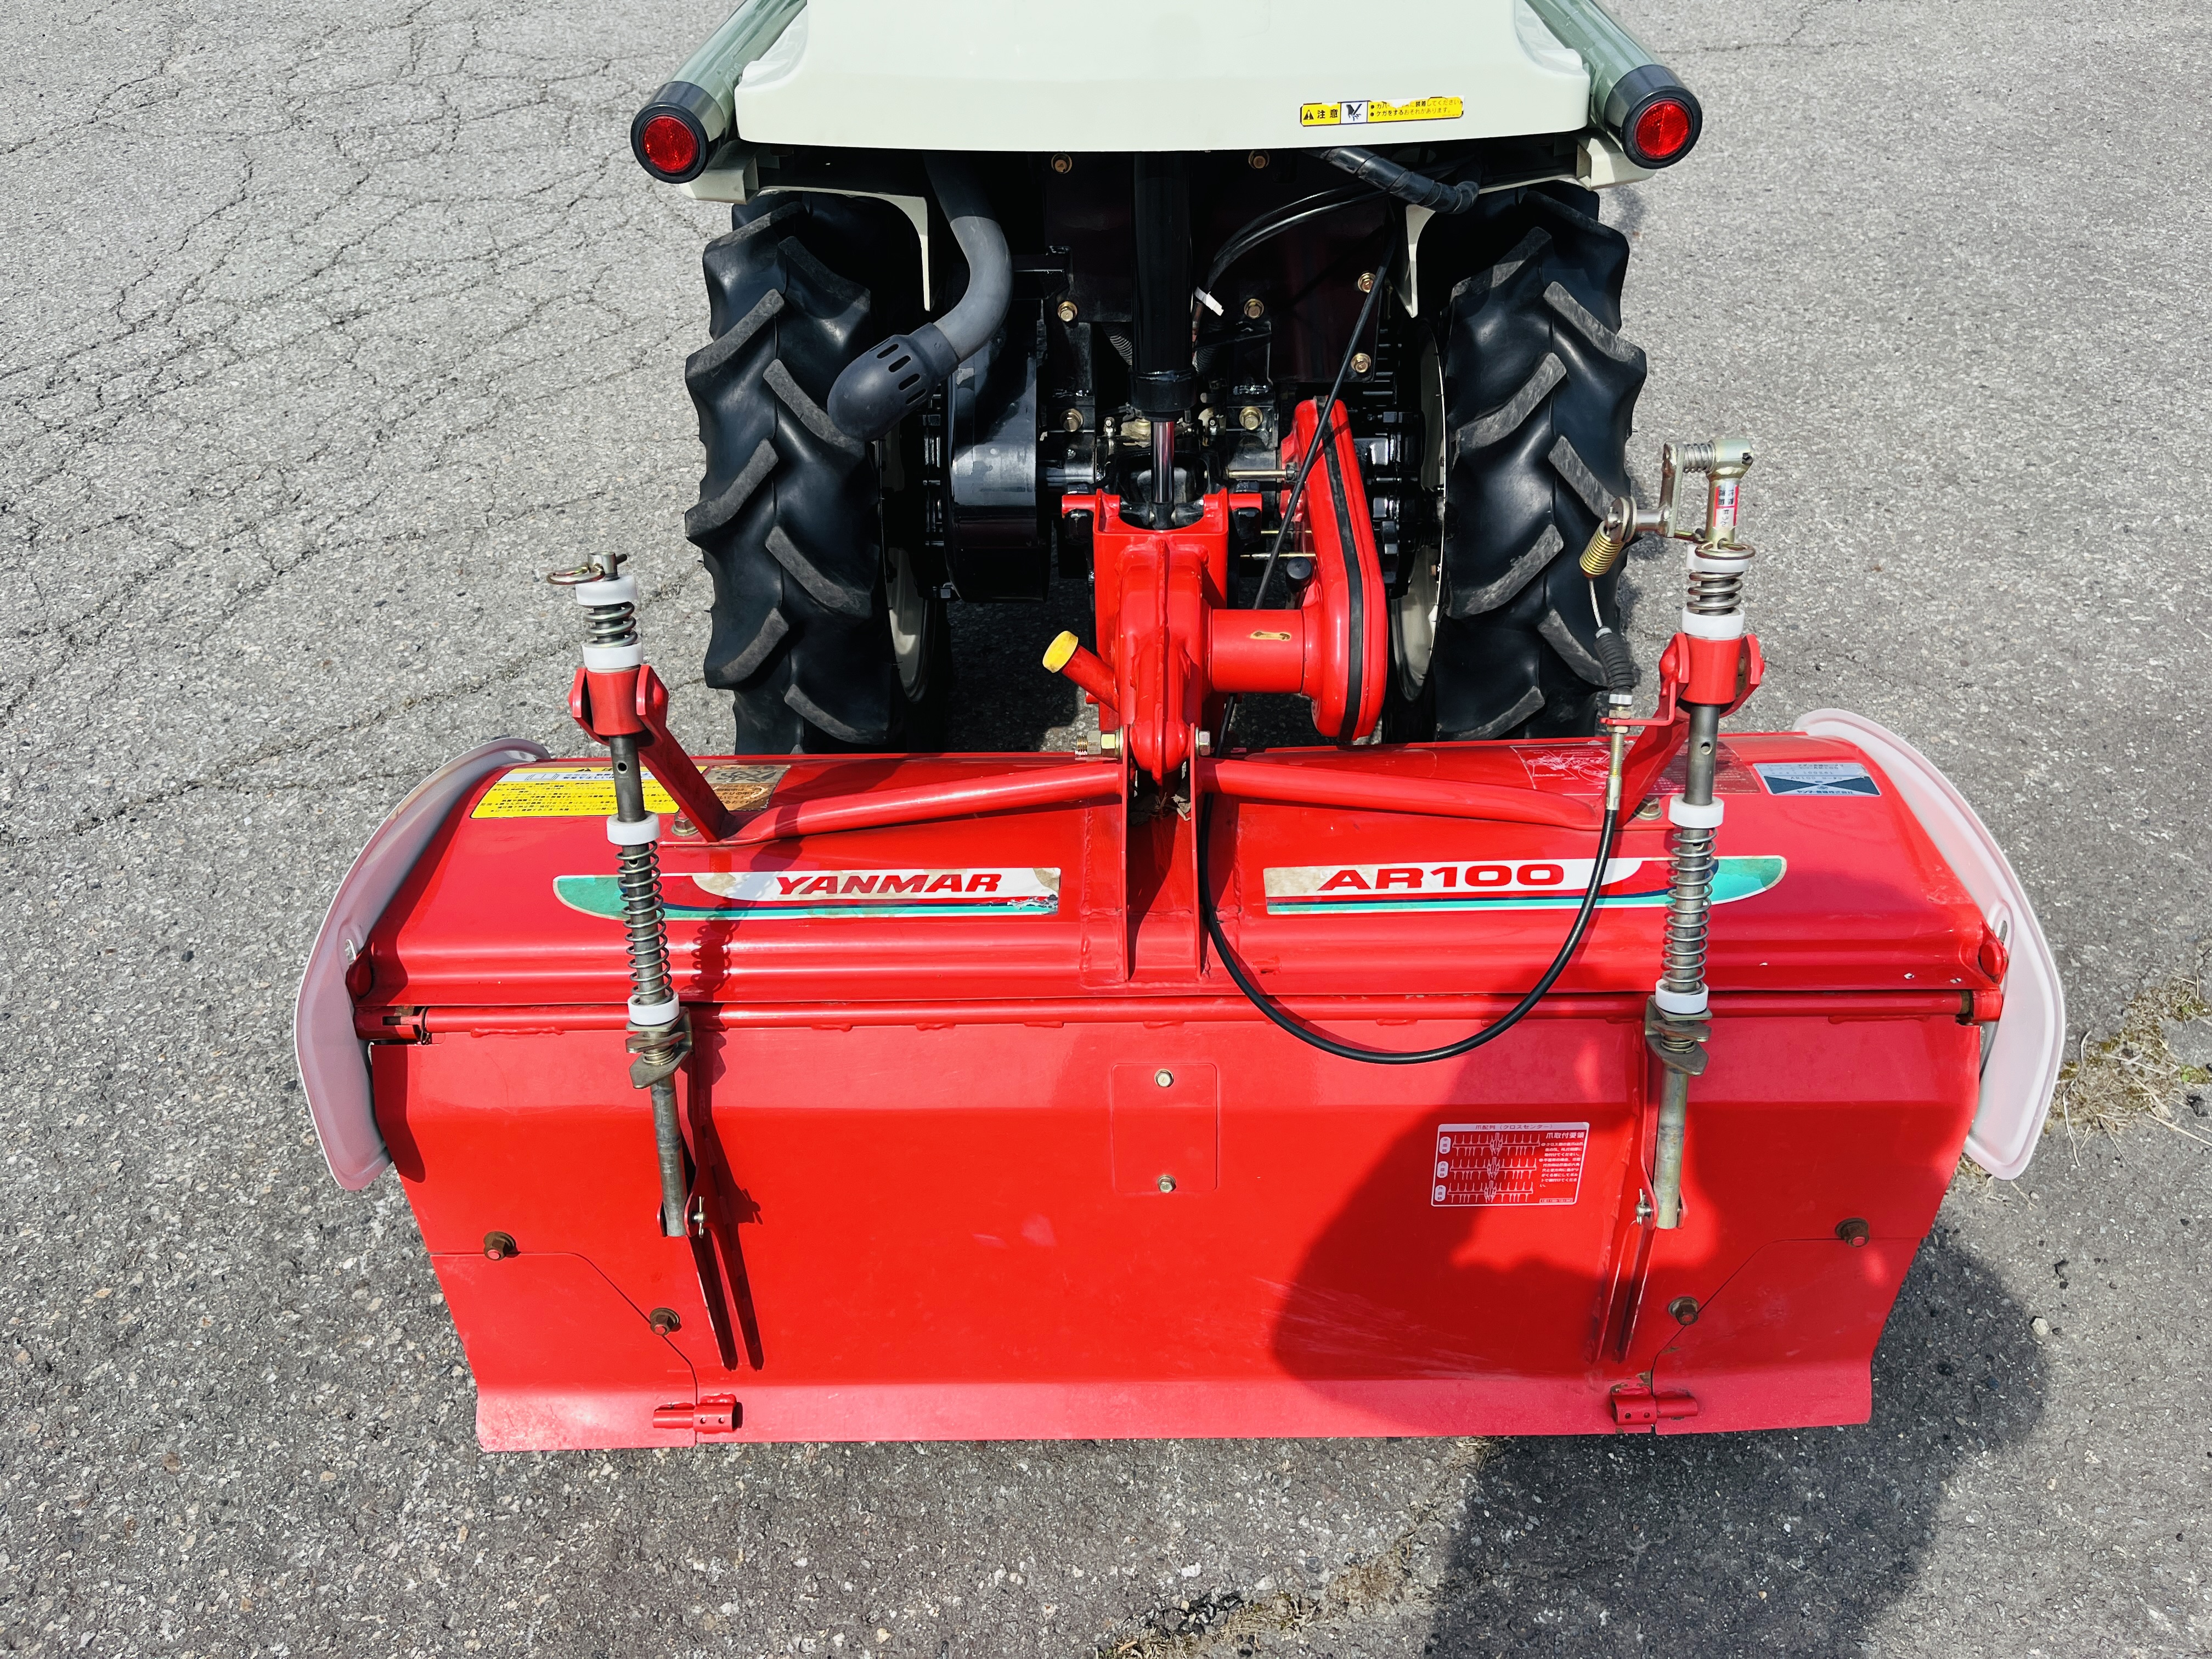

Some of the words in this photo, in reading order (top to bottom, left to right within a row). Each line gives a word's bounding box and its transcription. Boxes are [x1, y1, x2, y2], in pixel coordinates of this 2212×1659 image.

[1317, 109, 1338, 119] 注意
[1376, 107, 1451, 117] ケガをするおそれがあります。
[777, 874, 1002, 895] YANMAR
[1317, 864, 1564, 891] AR100
